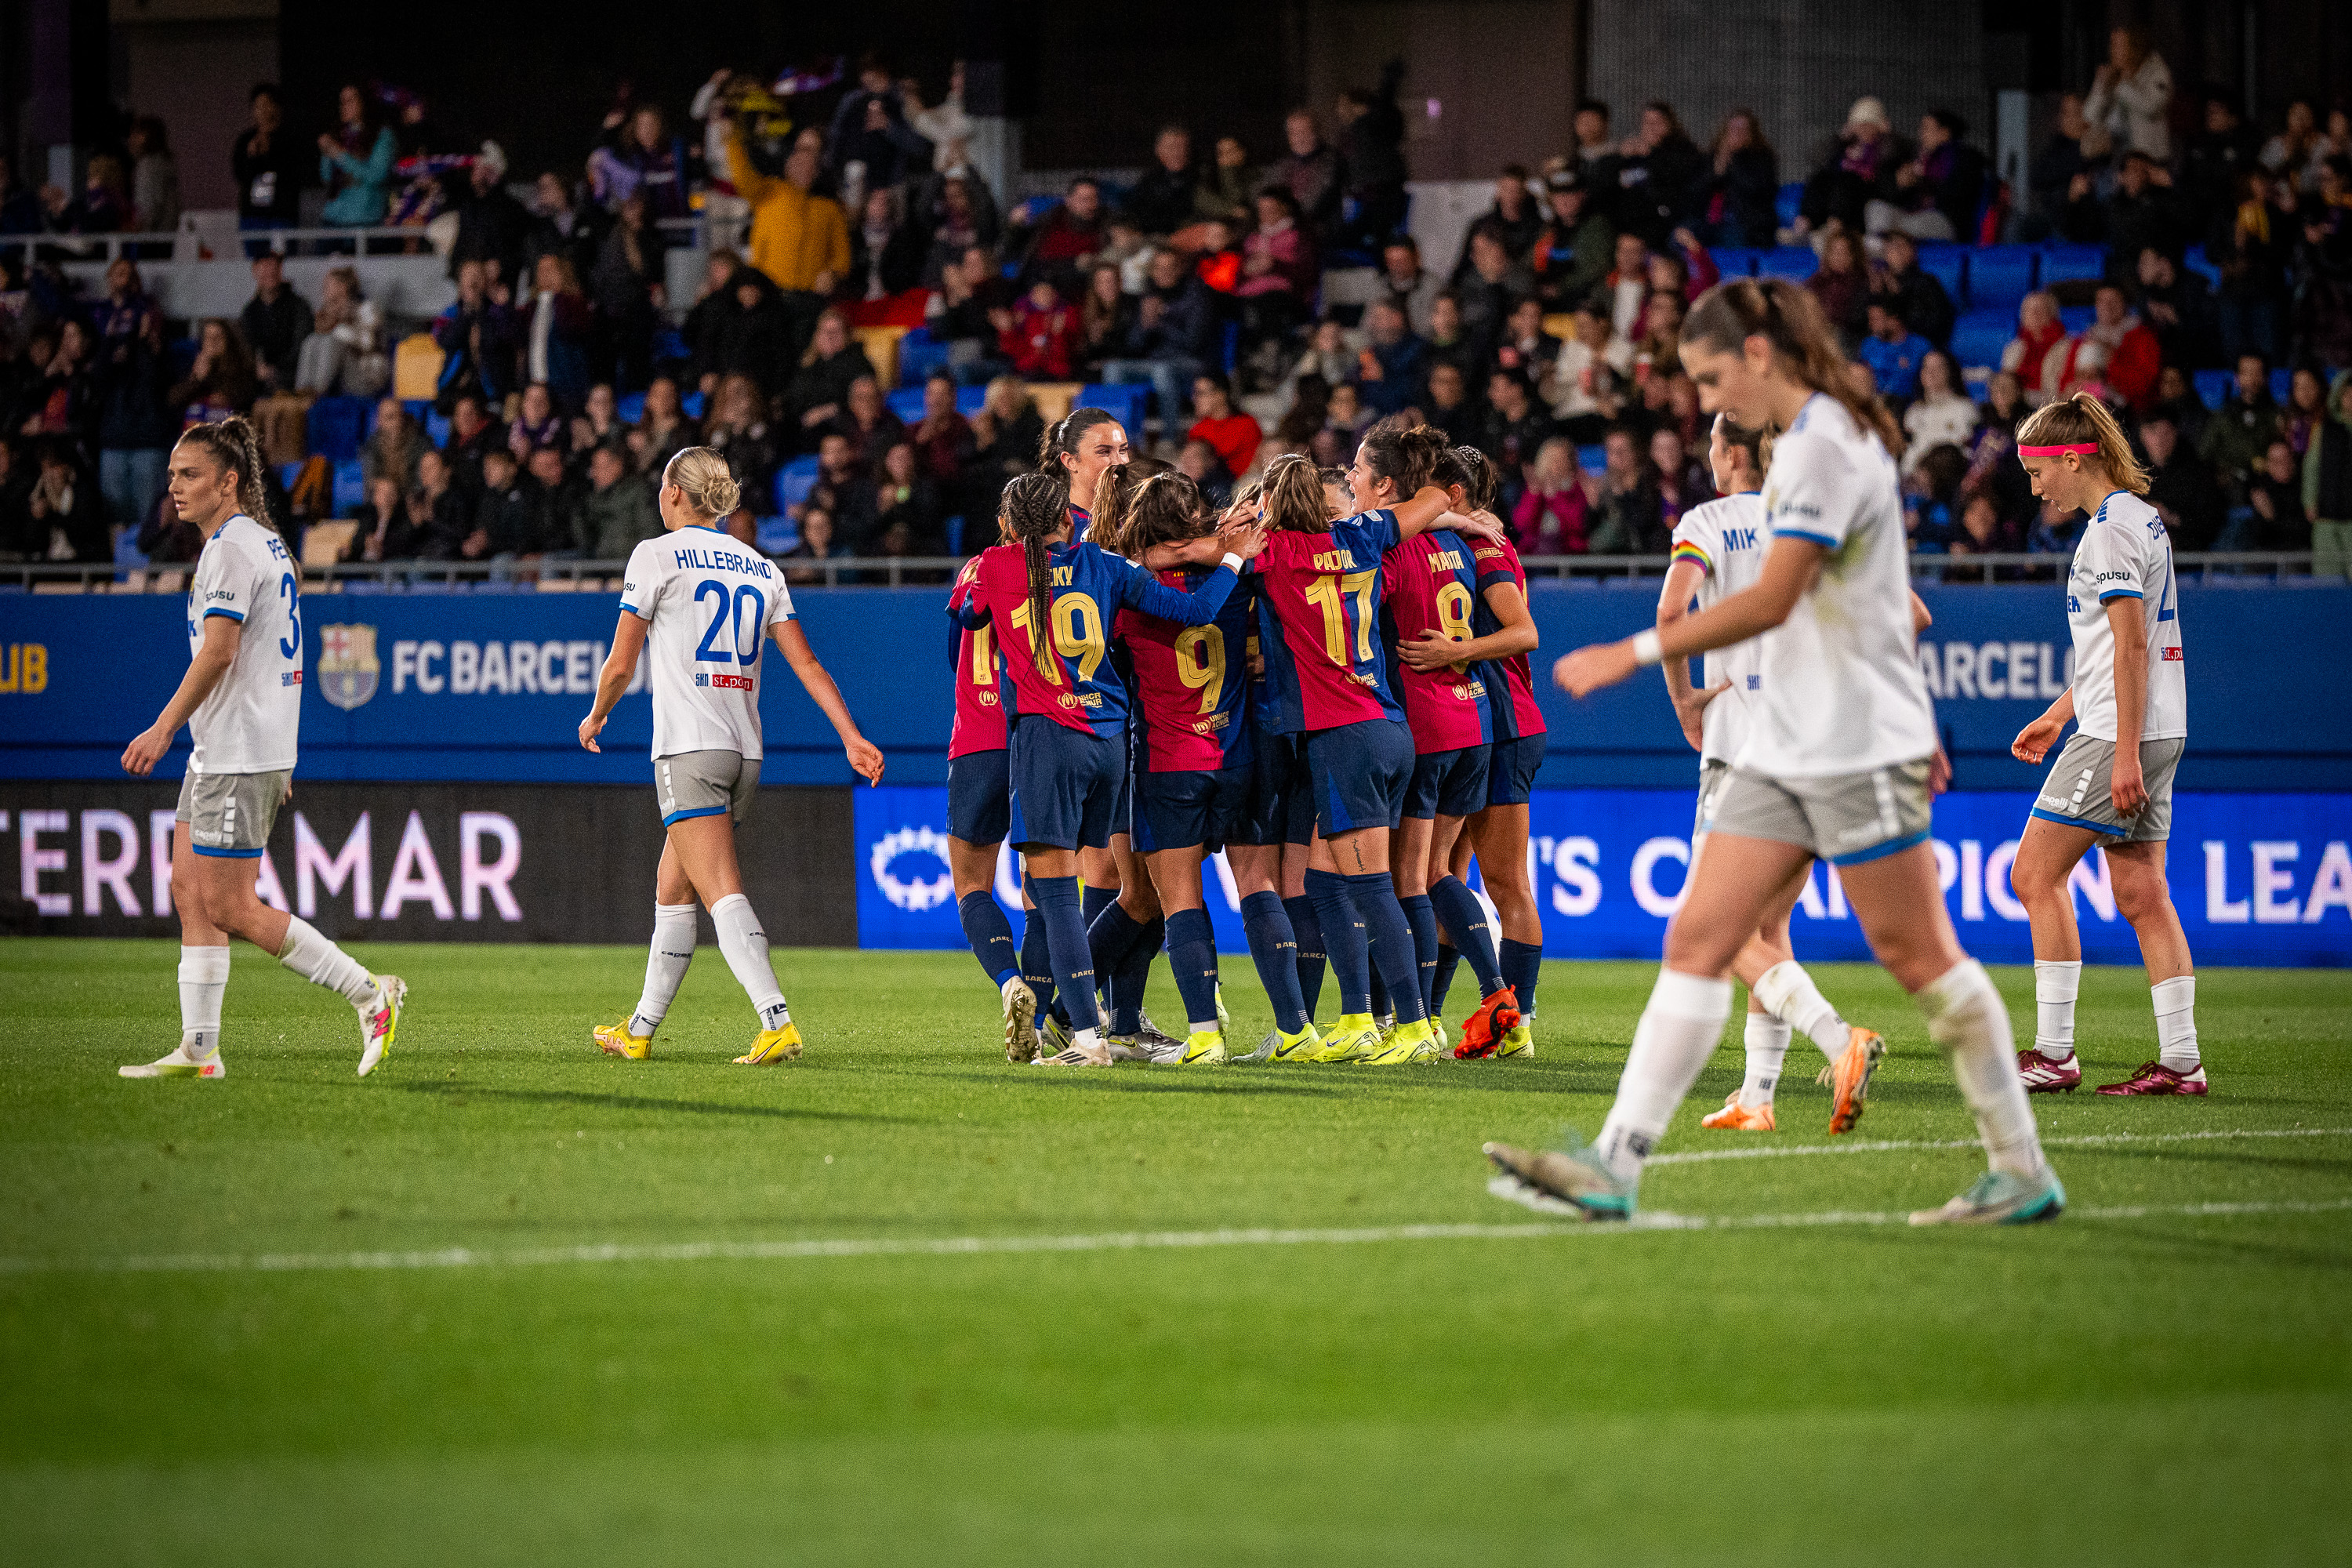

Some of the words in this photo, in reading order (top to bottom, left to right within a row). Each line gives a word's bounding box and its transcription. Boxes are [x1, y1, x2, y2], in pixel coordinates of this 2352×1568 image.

[674, 549, 771, 579] HILLEBRAND
[1313, 550, 1357, 571] PAJOR
[2096, 571, 2130, 583] spusu
[280, 572, 300, 660] 3
[694, 579, 765, 666] 20
[1011, 592, 1105, 686] 19
[1305, 568, 1378, 666] 17
[394, 641, 445, 695] FC
[450, 641, 652, 695] BARCEL
[1174, 623, 1226, 714] 9
[1919, 641, 2075, 700] ARCEL
[0, 809, 522, 922] ERMAR
